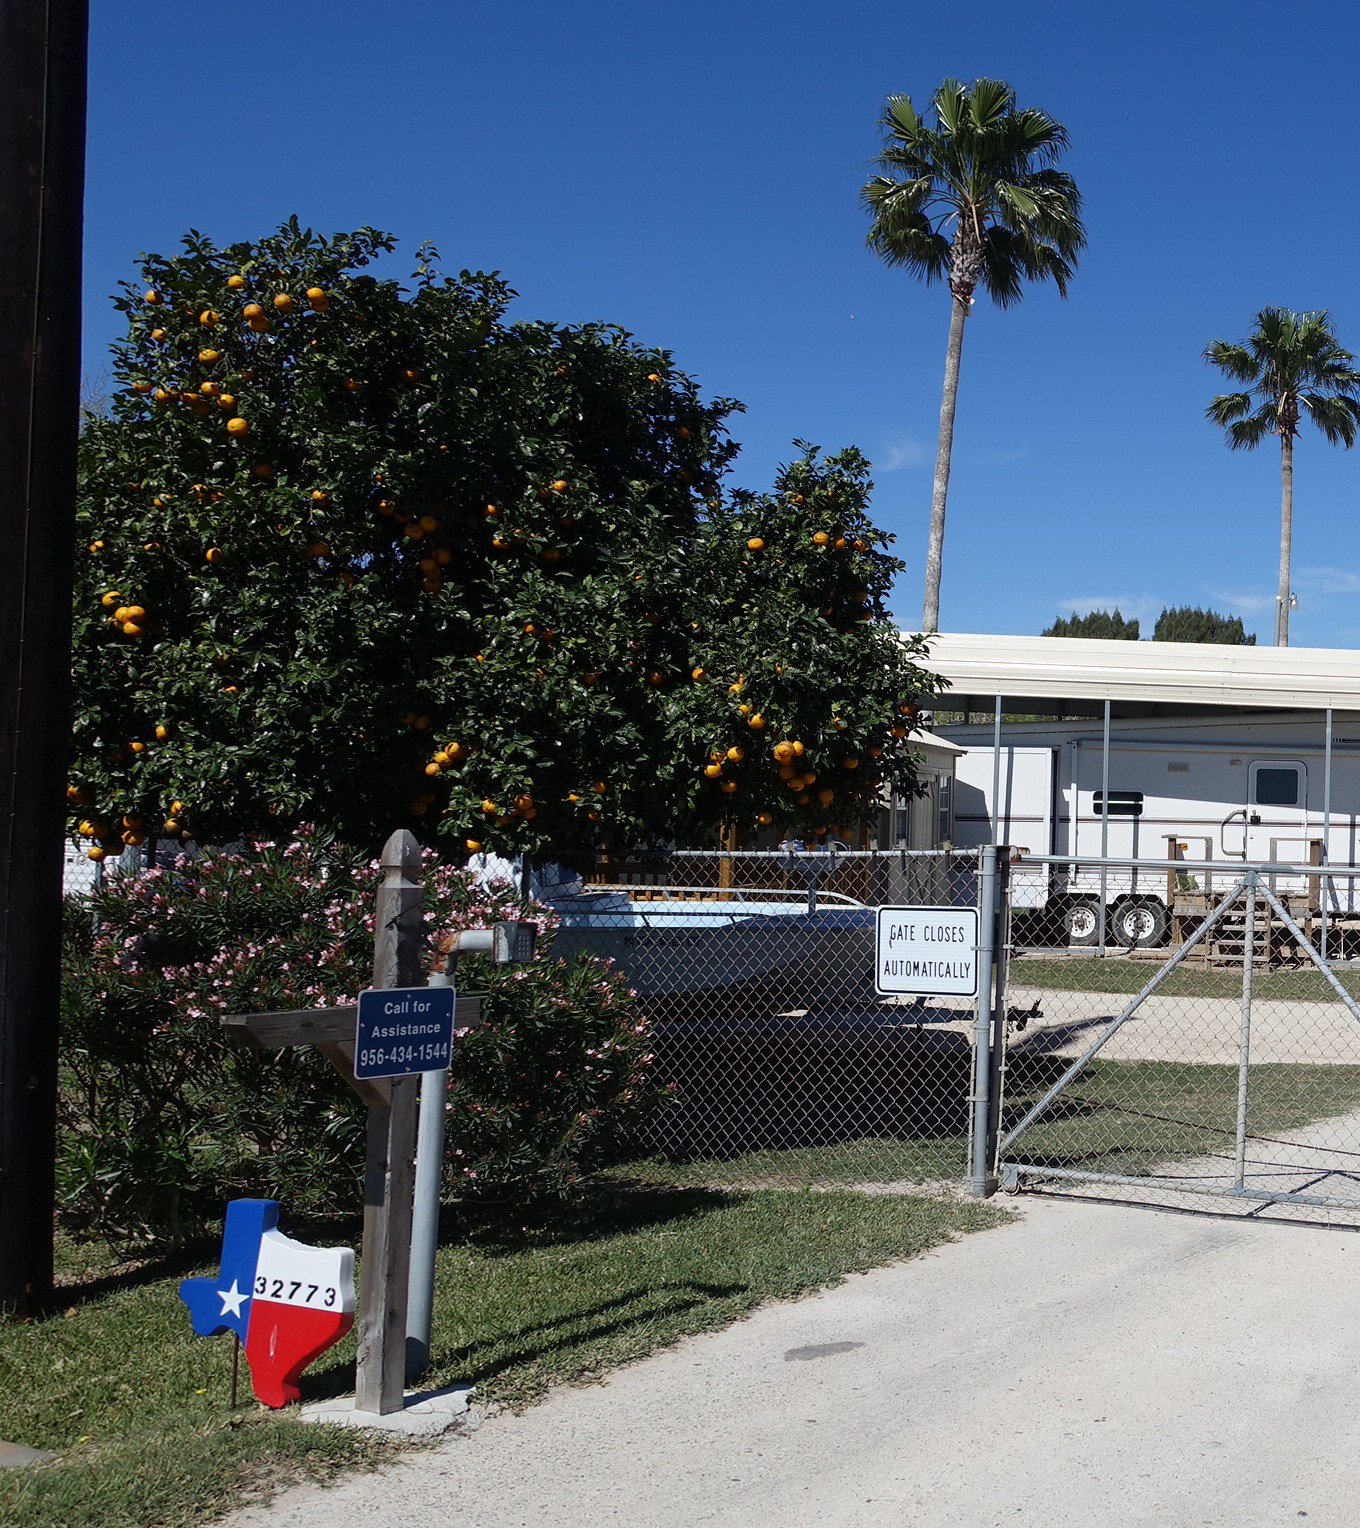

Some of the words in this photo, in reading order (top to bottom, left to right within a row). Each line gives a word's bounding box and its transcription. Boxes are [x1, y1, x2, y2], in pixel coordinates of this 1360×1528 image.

[890, 924, 915, 941] GATE
[923, 925, 965, 942] CLOSES
[883, 960, 971, 978] AUTOMATICALLY
[384, 1001, 409, 1014] Call
[413, 1000, 431, 1012] for
[371, 1023, 441, 1038] Assistance
[360, 1042, 448, 1066] 956-434-1544
[254, 1276, 336, 1307] 32773
